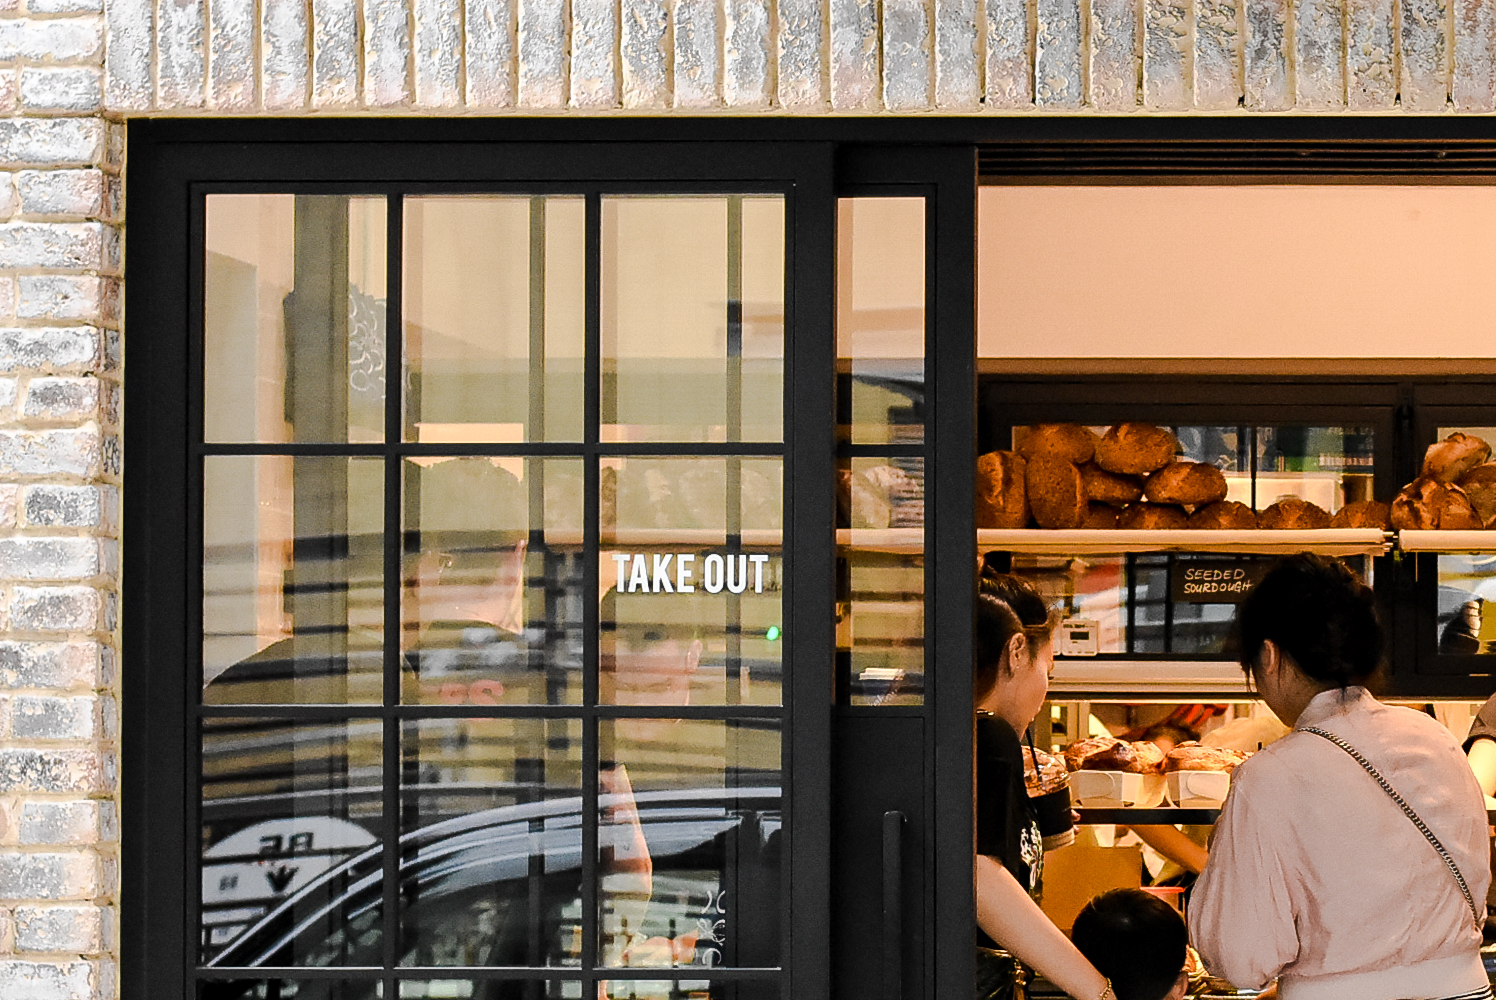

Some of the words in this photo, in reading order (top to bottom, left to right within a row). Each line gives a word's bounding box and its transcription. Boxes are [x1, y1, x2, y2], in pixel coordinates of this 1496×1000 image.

[612, 553, 696, 594] TAKE
[704, 553, 769, 594] OUT
[1184, 568, 1245, 580] SEEDED
[1184, 580, 1253, 594] SOURDOUGH
